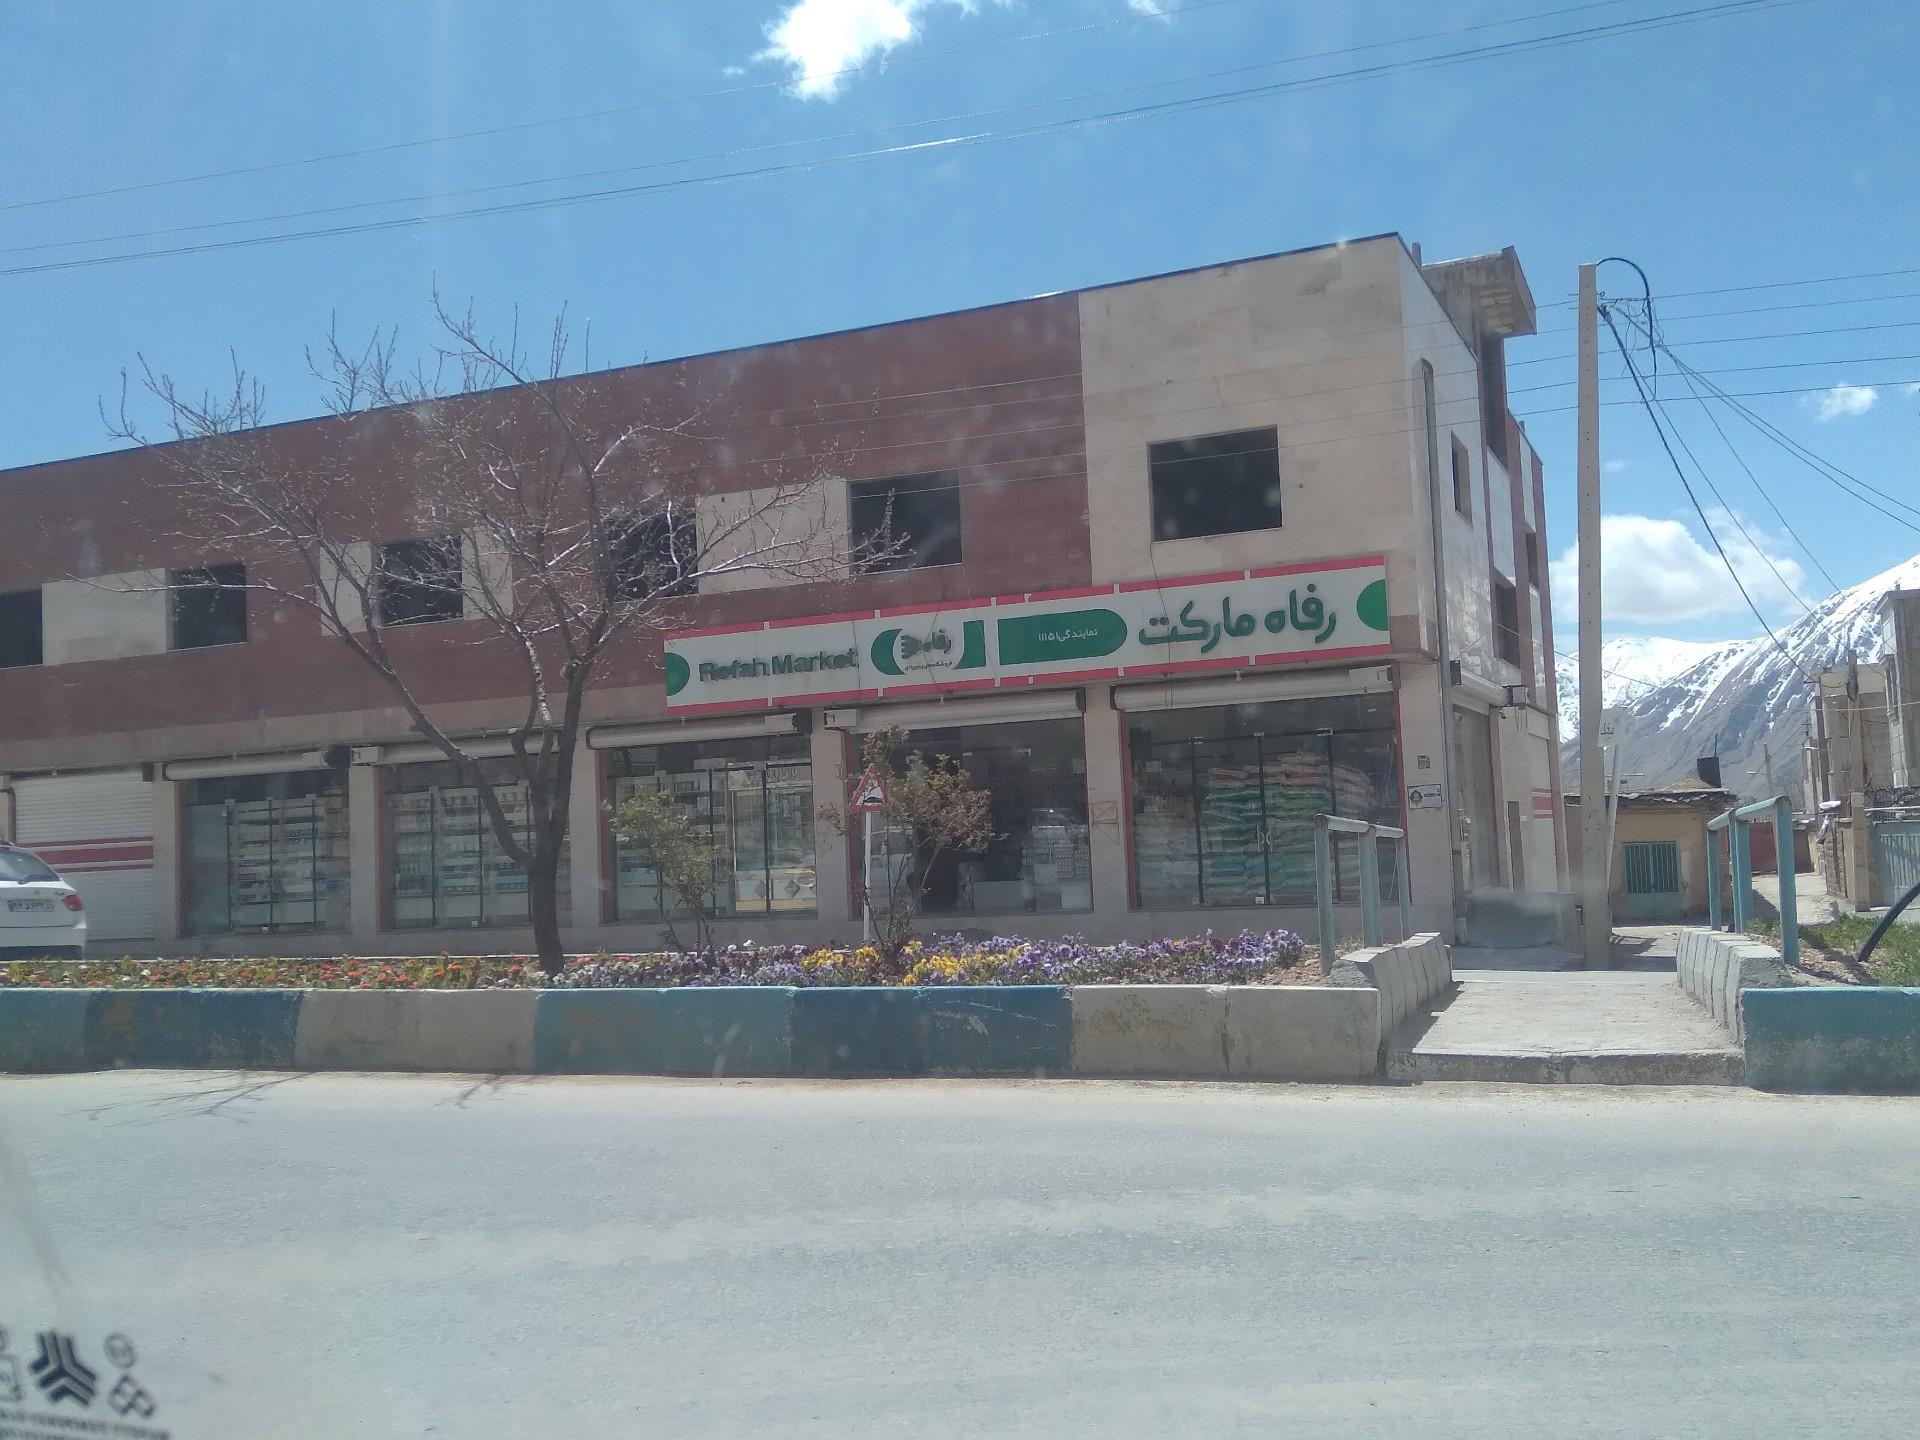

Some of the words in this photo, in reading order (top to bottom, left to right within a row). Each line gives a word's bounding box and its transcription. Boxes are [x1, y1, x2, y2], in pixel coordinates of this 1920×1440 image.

[1138, 596, 1256, 653] مارکت
[1264, 583, 1337, 644] رفاه
[698, 656, 768, 682] Refah
[771, 648, 859, 676] Market
